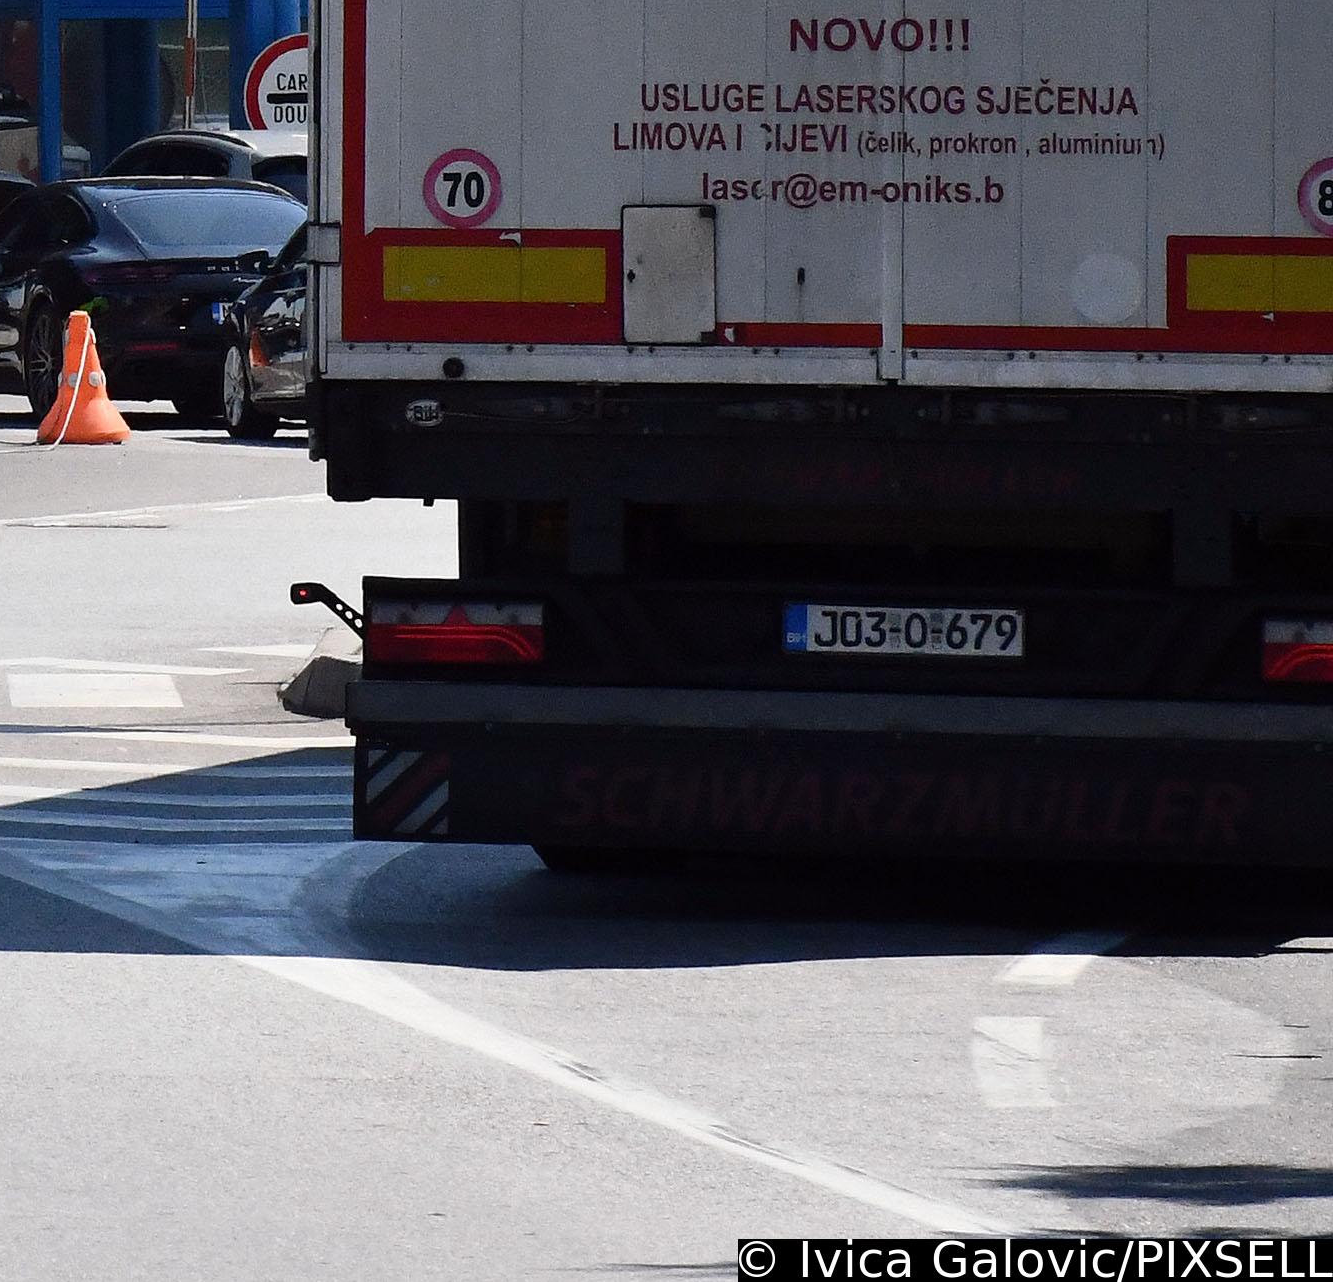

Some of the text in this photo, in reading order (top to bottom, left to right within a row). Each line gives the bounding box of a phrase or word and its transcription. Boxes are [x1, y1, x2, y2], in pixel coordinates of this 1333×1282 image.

[790, 17, 972, 53] NOVO!!!
[642, 78, 1139, 116] USLUGE LASERSKOG SJEČENJA
[613, 122, 727, 151] LIMOVA
[736, 123, 743, 152] I
[857, 130, 922, 159] (čelik,
[929, 132, 1017, 159] prokron
[442, 171, 486, 208] 70
